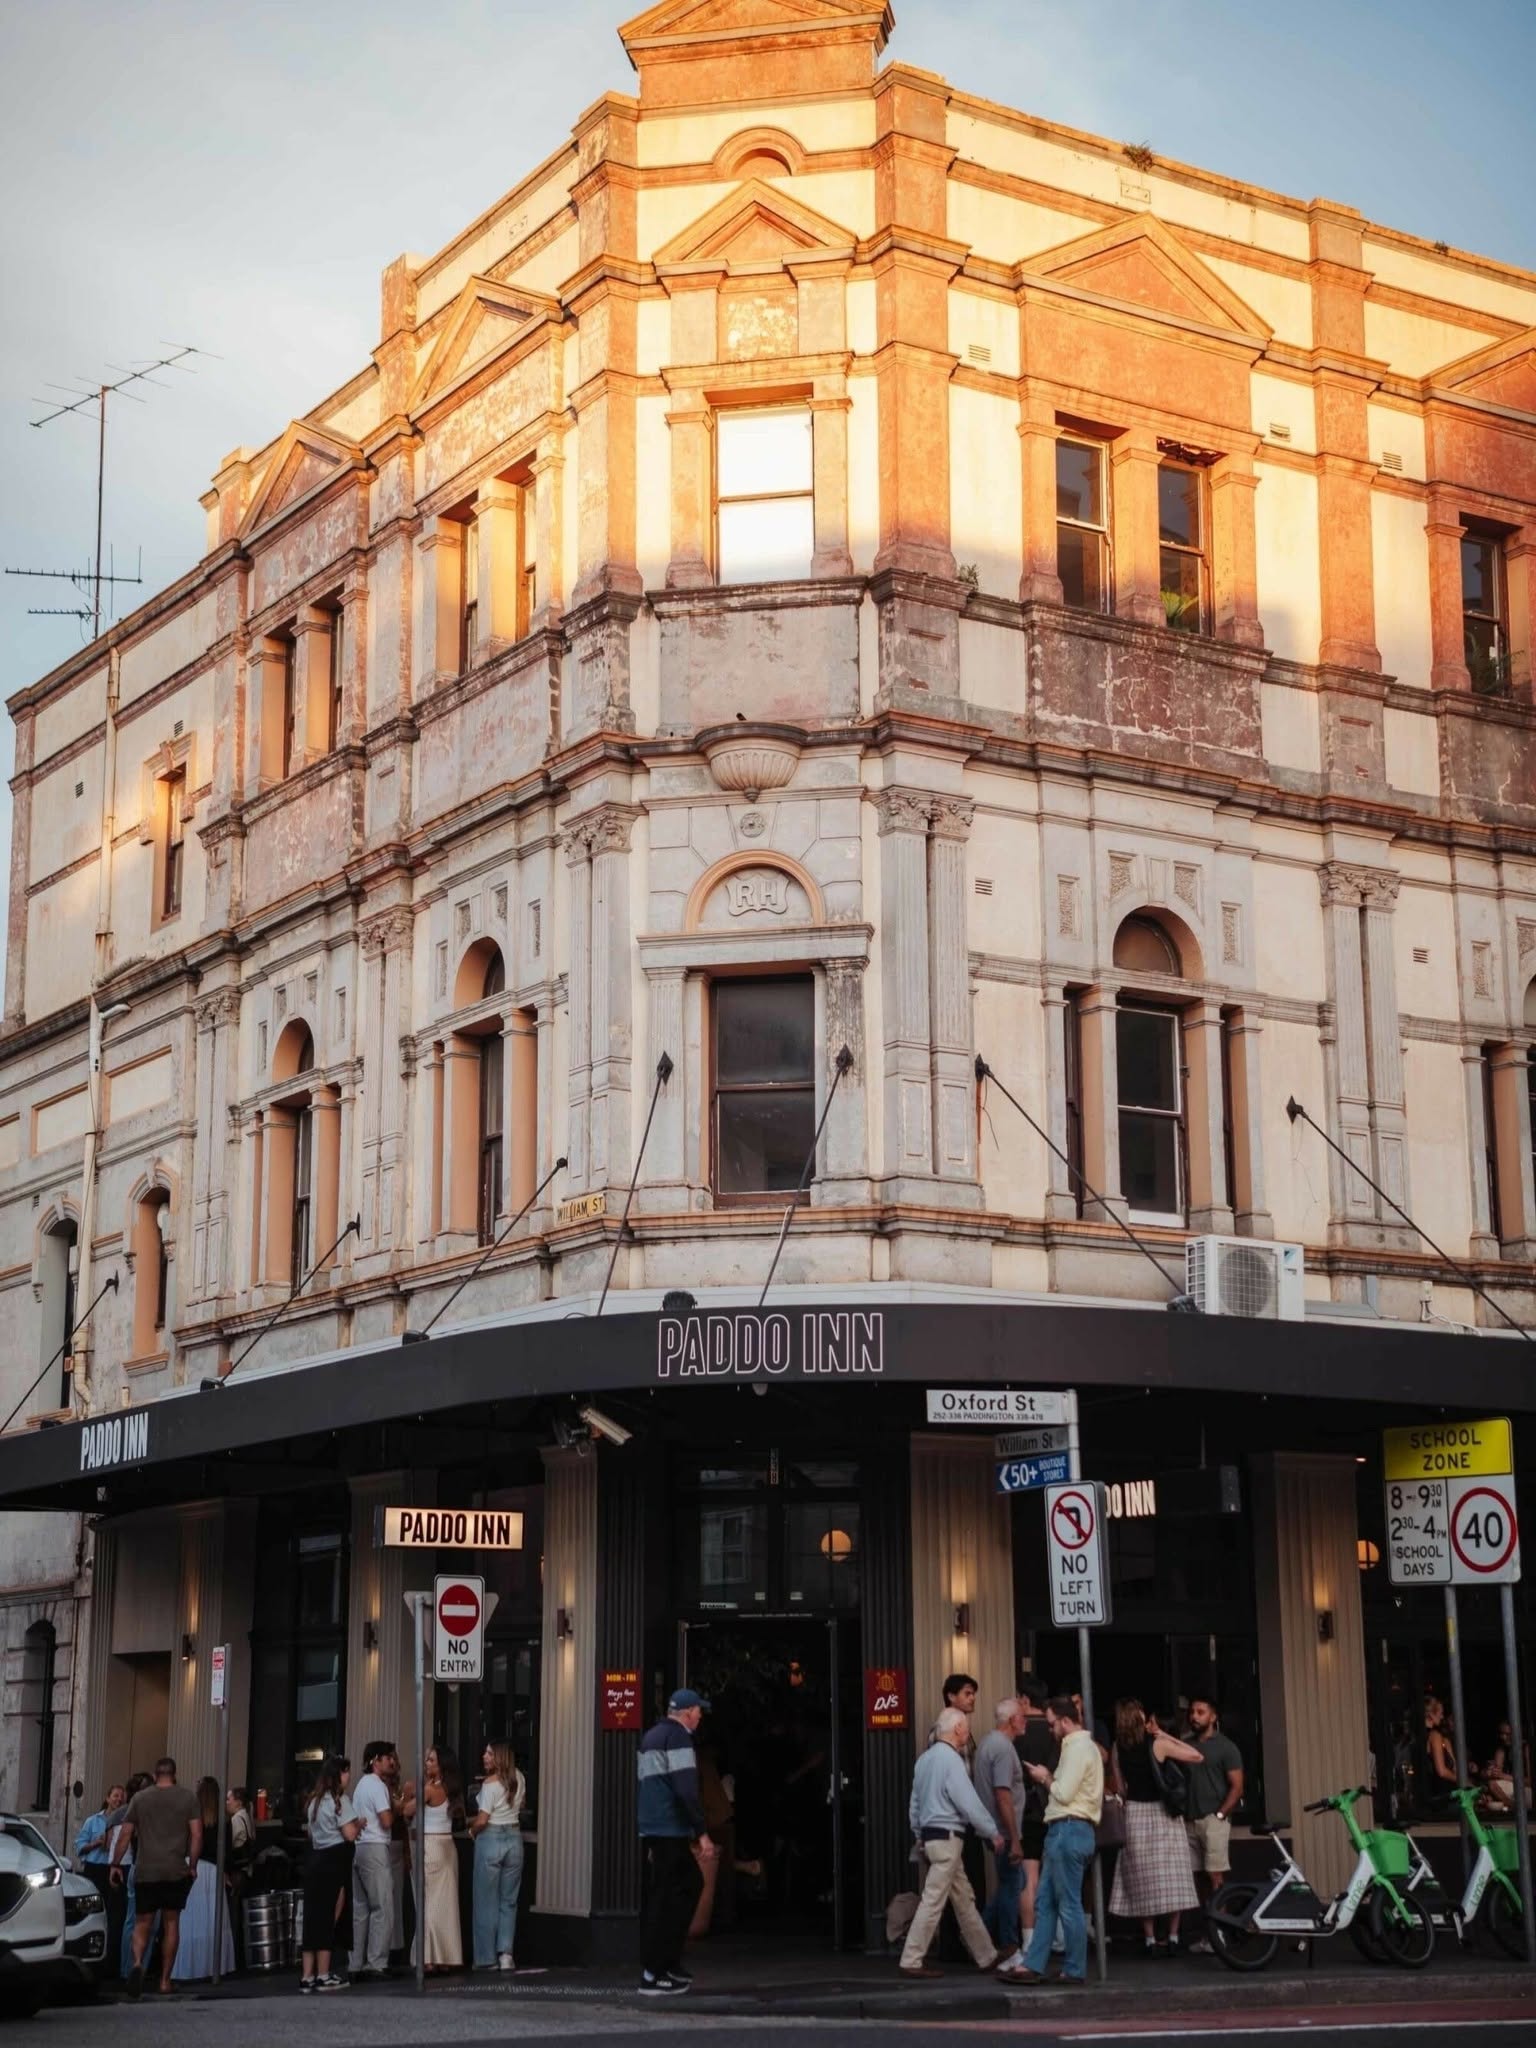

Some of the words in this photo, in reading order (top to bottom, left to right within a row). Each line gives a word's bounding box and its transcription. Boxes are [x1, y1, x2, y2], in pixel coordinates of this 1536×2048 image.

[592, 1197, 603, 1212] ST
[658, 1314, 790, 1377] PADDO
[803, 1313, 883, 1373] INN
[942, 1393, 1008, 1411] Oxford
[1015, 1394, 1035, 1411] St
[963, 1412, 1014, 1421] PADDINGTON
[80, 1418, 122, 1471] PADDO
[123, 1411, 149, 1462] INN
[1000, 1435, 1038, 1451] William
[1042, 1432, 1053, 1449] St
[1410, 1428, 1482, 1449] SCHOOL
[1039, 1455, 1067, 1471] BOUTIQUE
[1423, 1452, 1471, 1471] ZONE
[1043, 1469, 1065, 1482] STORES
[1124, 1480, 1156, 1518] INN
[400, 1512, 467, 1545] PADDO
[473, 1514, 511, 1546] INN
[1462, 1511, 1503, 1549] 40
[1396, 1545, 1444, 1560] SCHOOL
[1061, 1554, 1088, 1575] NO
[1403, 1563, 1435, 1576] DAYS
[1060, 1580, 1093, 1595] LEFT
[1059, 1602, 1096, 1616] TURN
[448, 1640, 469, 1655] NO
[440, 1660, 475, 1673] ENTRY
